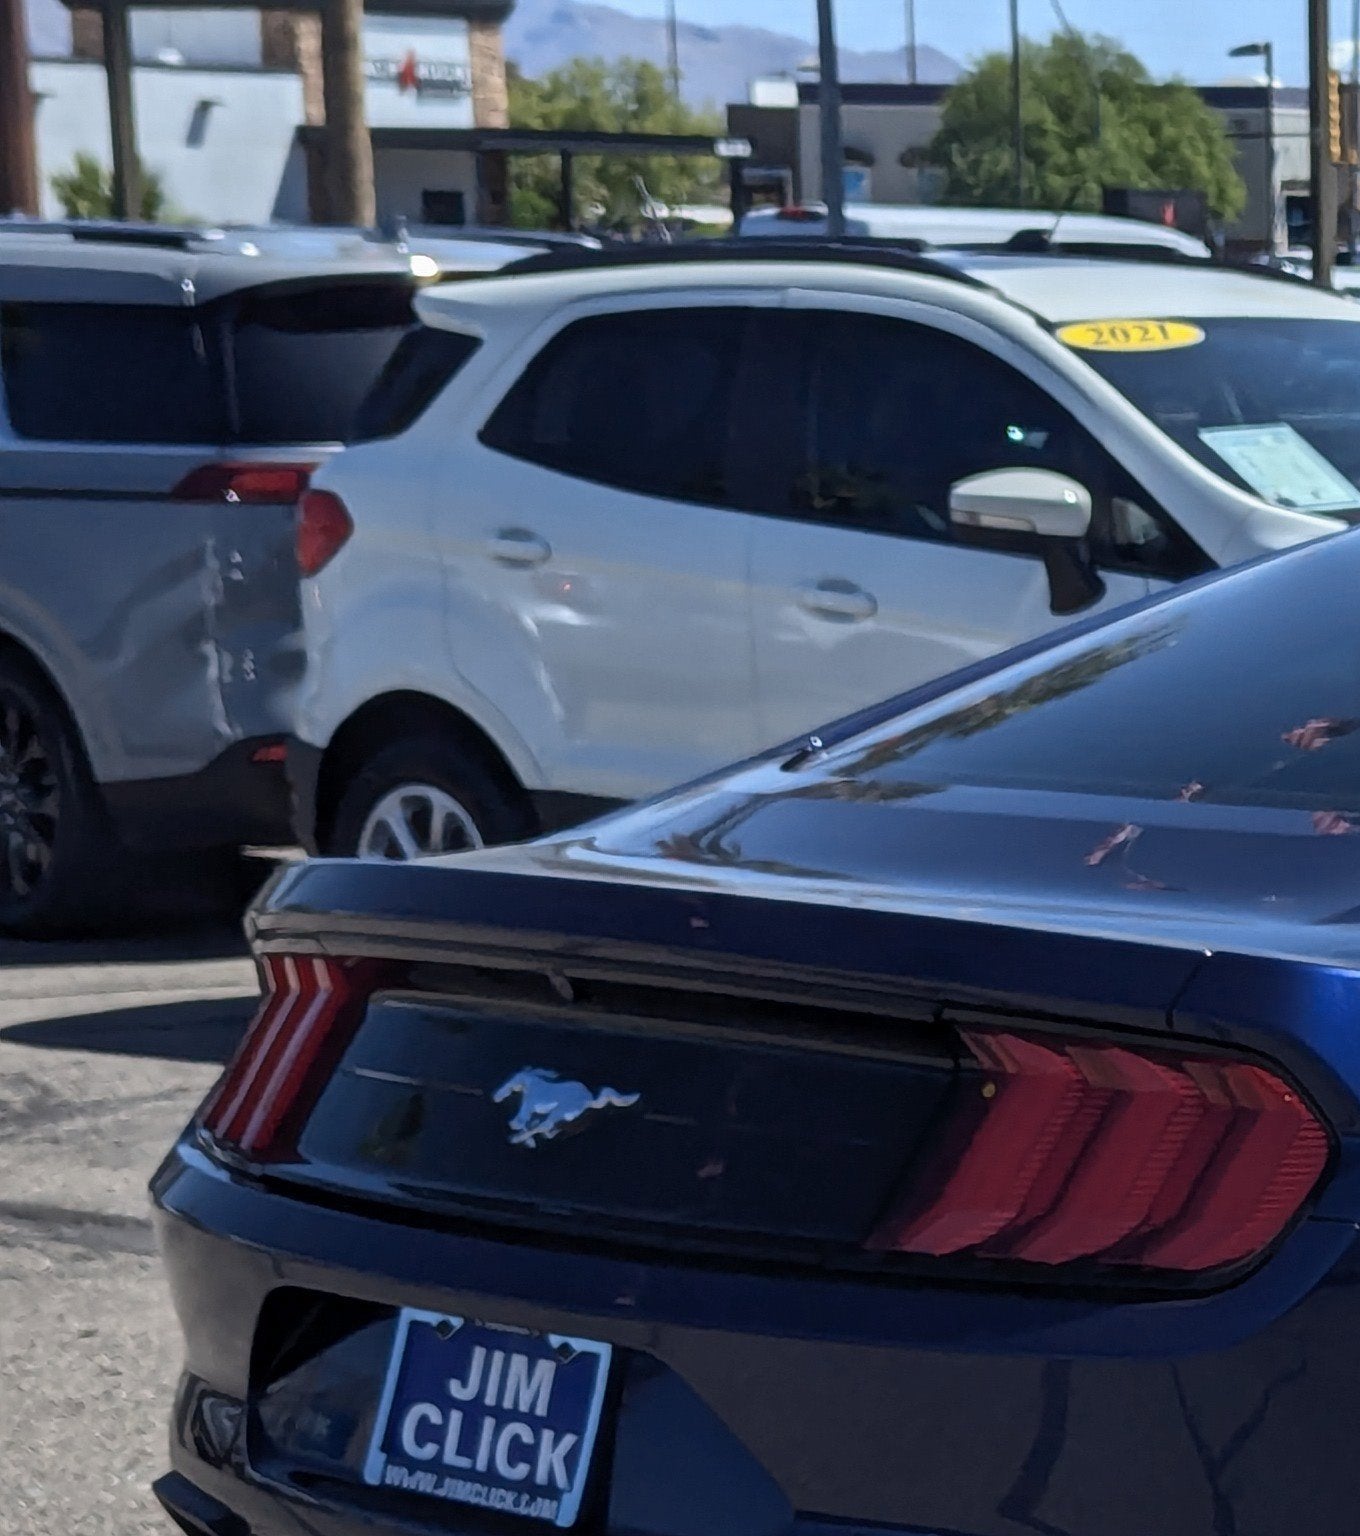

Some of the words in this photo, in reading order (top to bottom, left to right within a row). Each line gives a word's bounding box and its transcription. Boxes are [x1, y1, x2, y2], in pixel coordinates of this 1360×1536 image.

[1086, 323, 1170, 345] 2021
[449, 1345, 557, 1417] JIM
[402, 1402, 578, 1492] CLICK
